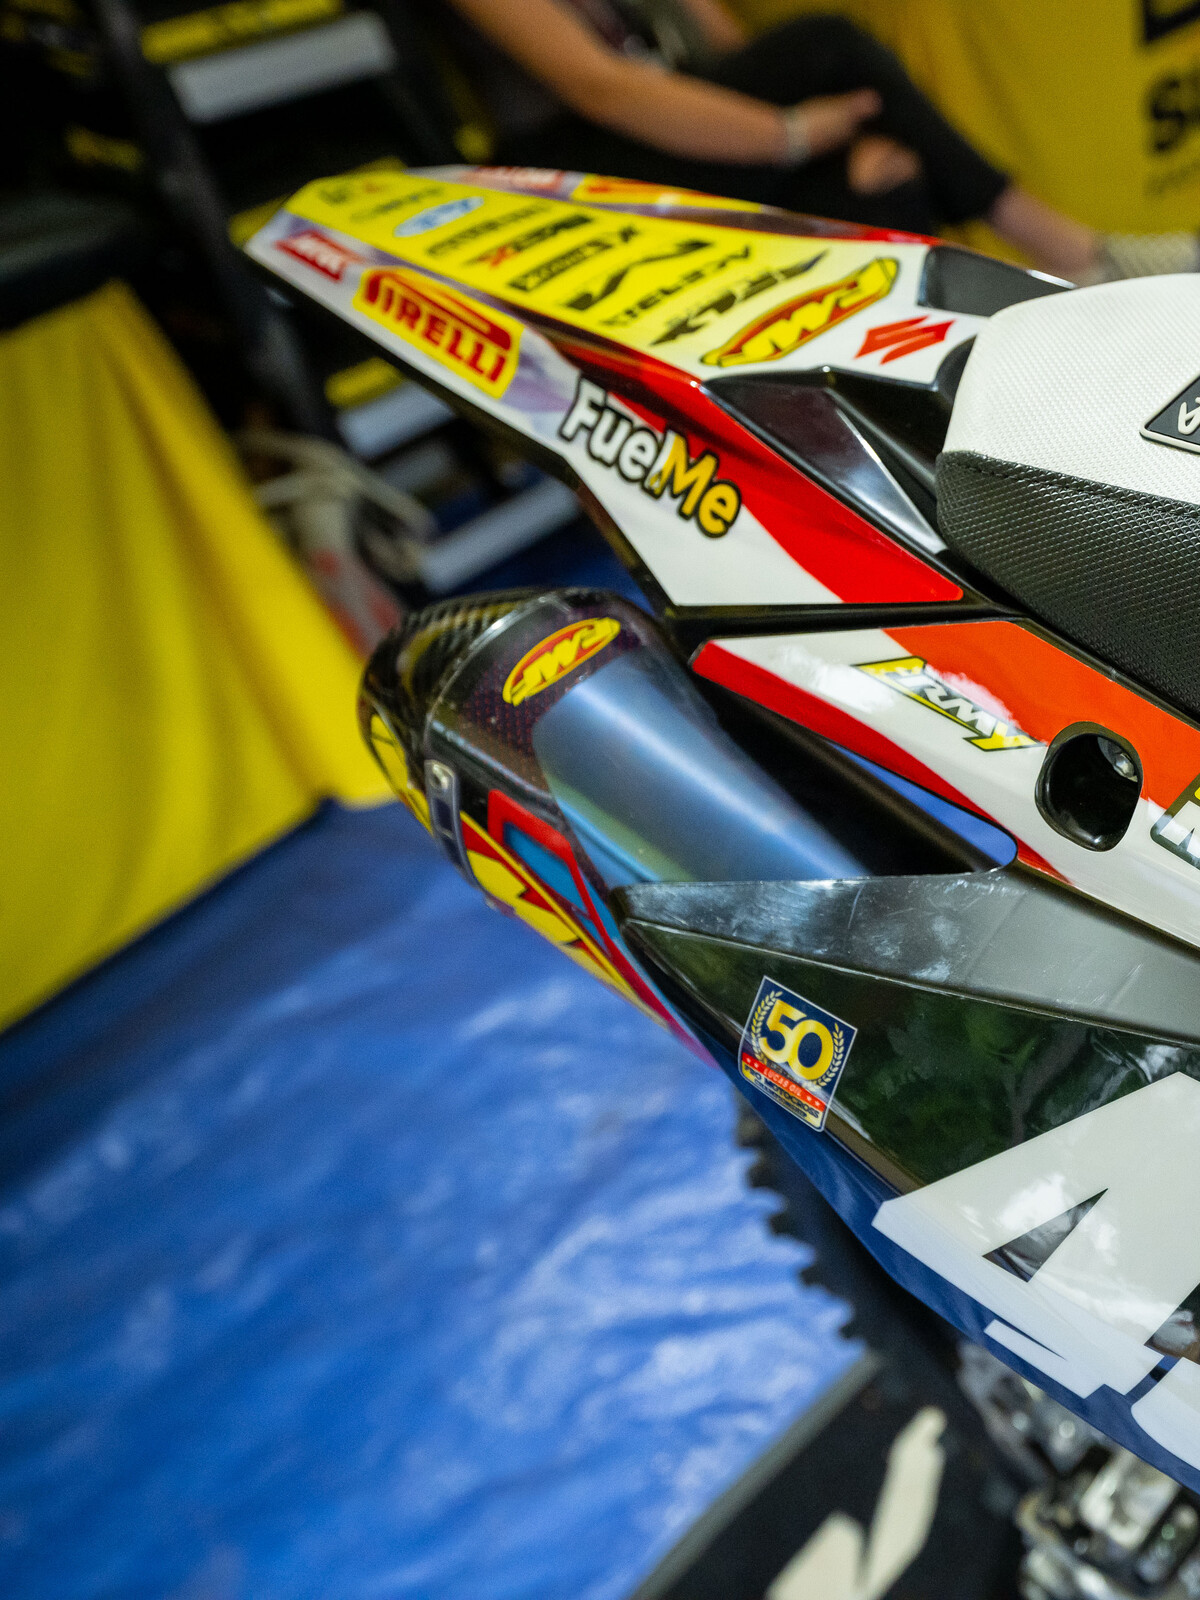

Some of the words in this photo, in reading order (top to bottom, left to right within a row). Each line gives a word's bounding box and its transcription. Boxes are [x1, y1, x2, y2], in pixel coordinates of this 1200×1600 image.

[365, 272, 511, 382] PIRELLI
[758, 999, 834, 1081] 50
[763, 1068, 789, 1088] LUCAS
[789, 1084, 802, 1097] OIL
